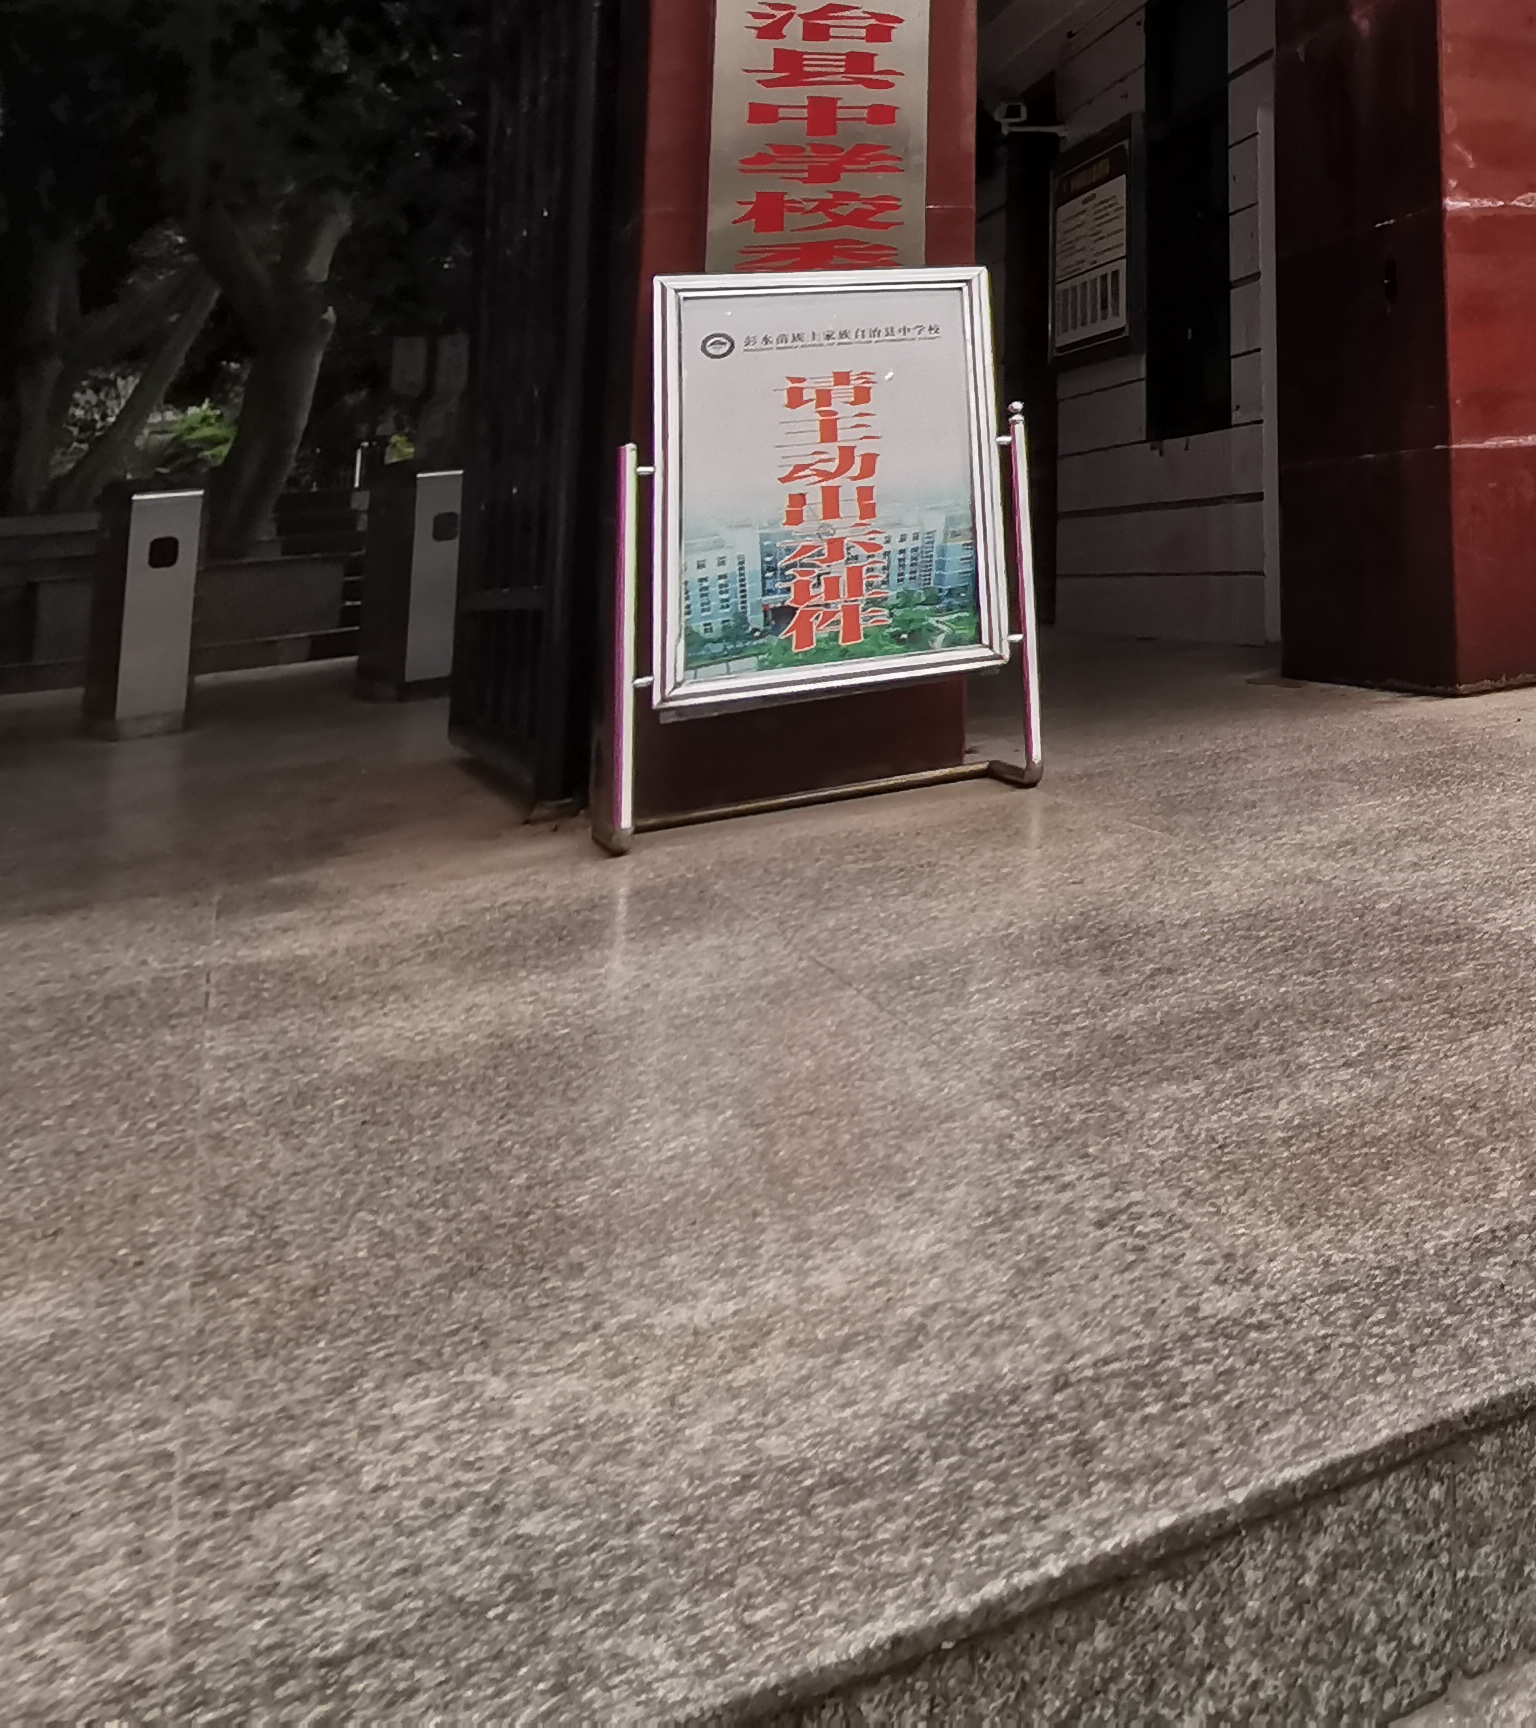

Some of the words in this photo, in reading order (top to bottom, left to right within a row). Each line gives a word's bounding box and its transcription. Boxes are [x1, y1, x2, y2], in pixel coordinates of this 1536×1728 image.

[773, 370, 892, 653] 请主动出示证件
